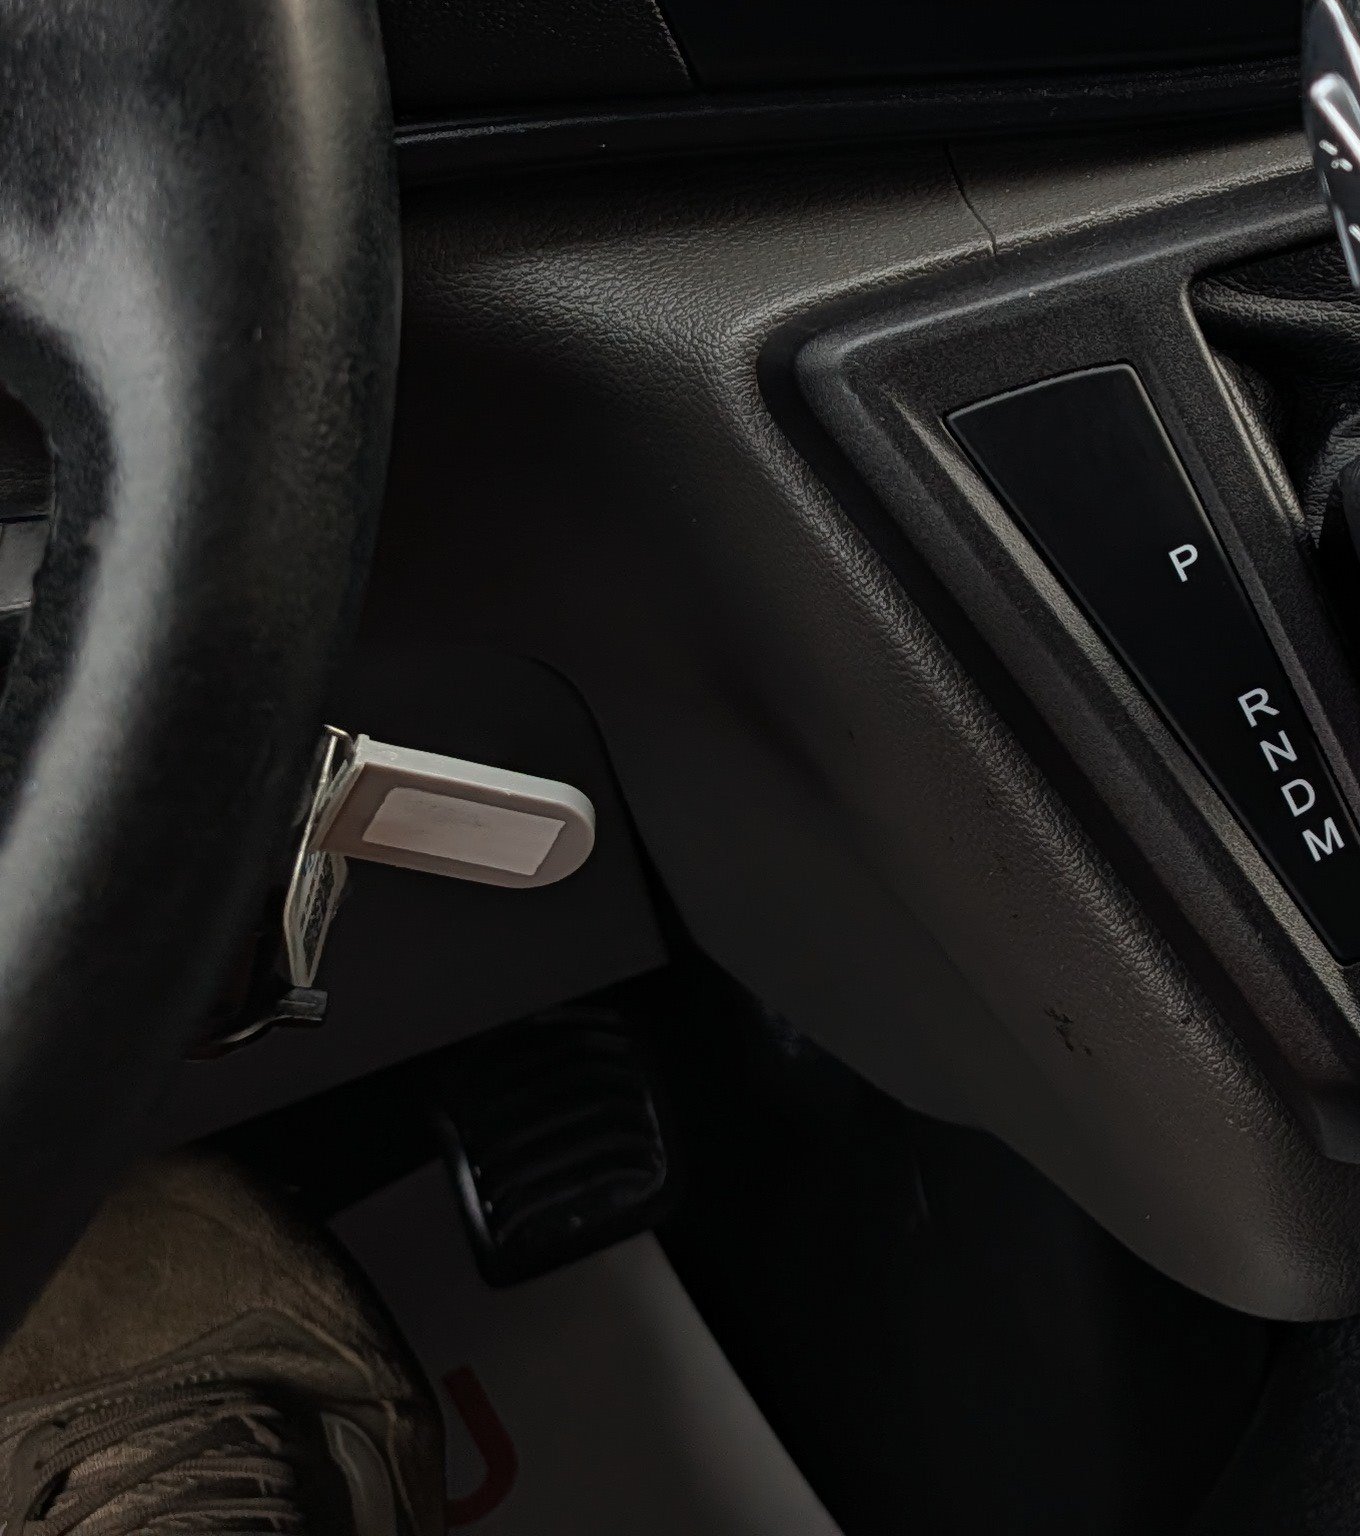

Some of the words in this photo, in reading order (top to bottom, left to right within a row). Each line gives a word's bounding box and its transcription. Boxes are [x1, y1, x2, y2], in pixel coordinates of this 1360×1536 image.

[1168, 543, 1199, 582] P
[1237, 687, 1280, 727] R
[1259, 730, 1298, 772] N
[1280, 778, 1317, 817] D
[1302, 816, 1346, 862] M
